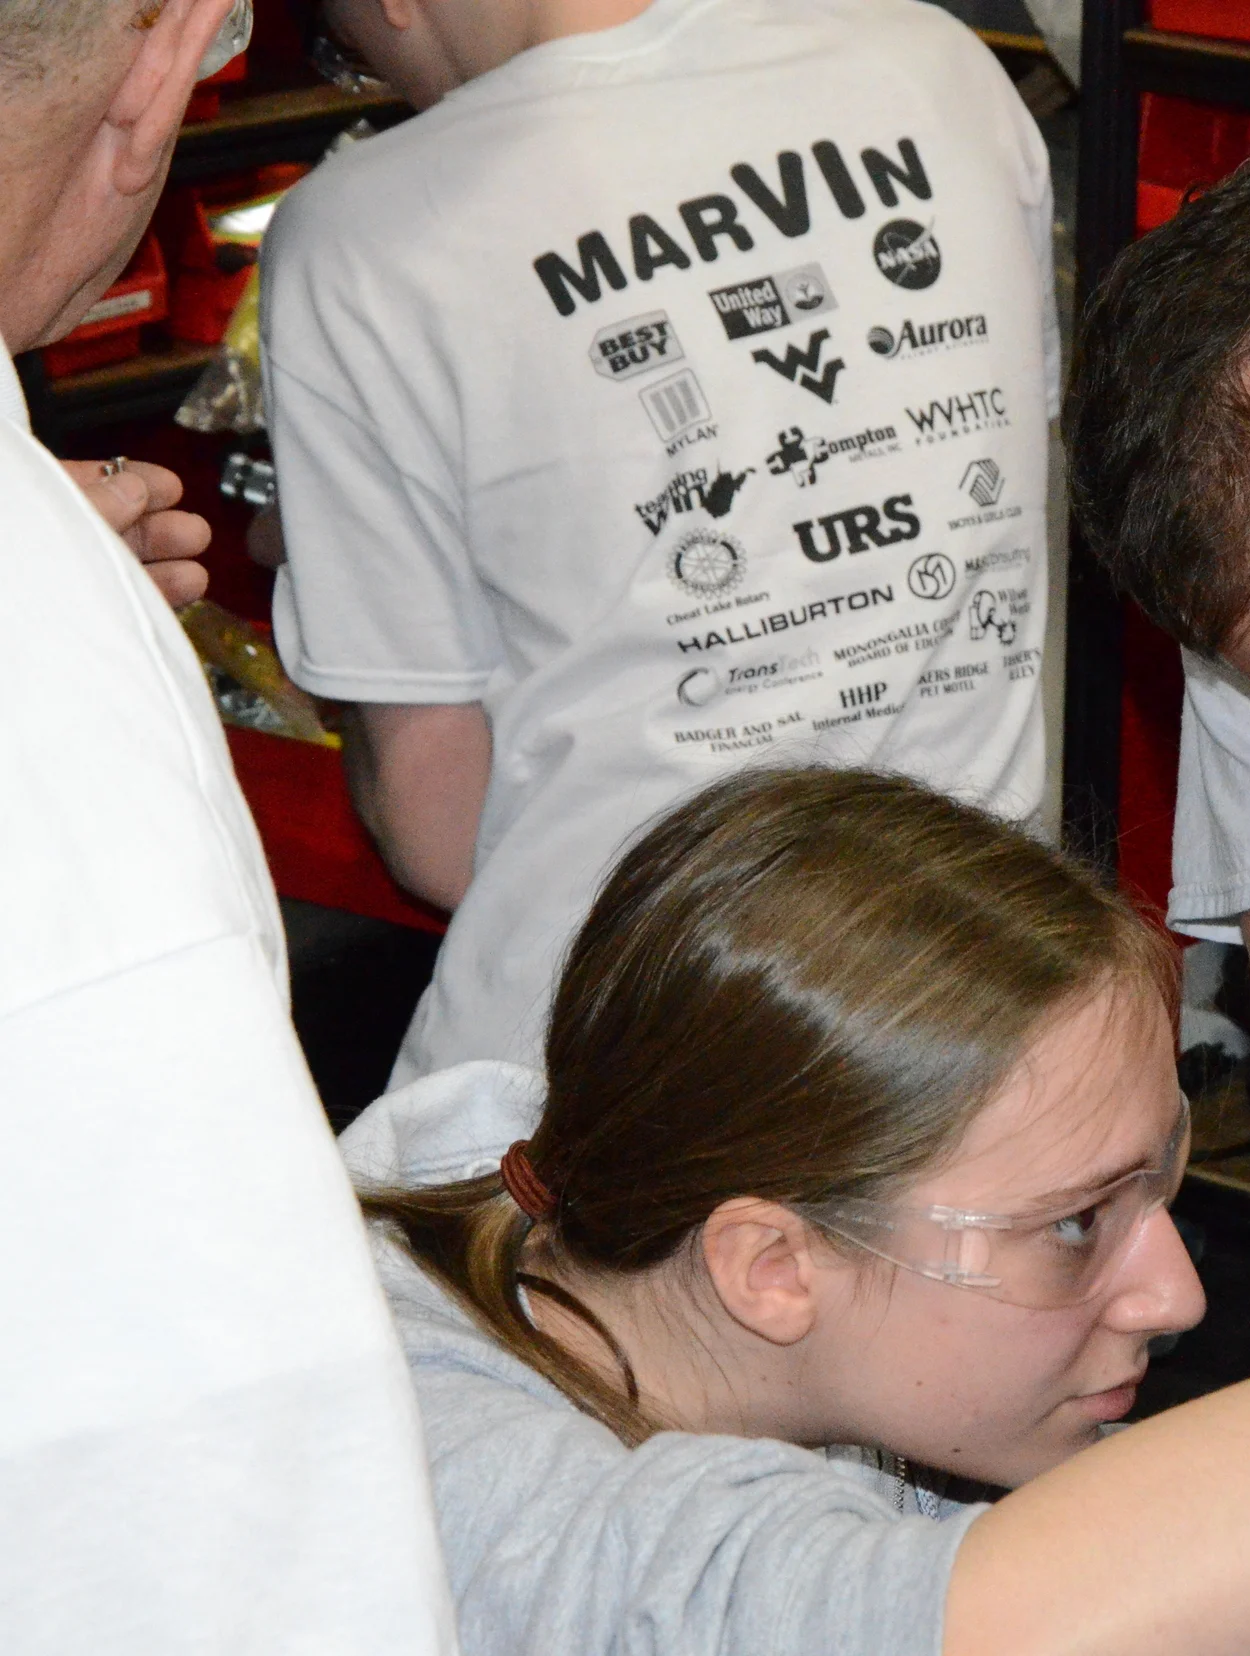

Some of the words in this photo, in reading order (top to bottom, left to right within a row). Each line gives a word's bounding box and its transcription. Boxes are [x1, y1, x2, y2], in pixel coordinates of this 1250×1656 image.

[533, 138, 933, 317] MARVIN
[878, 240, 938, 270] NASA
[711, 281, 776, 314] United
[743, 304, 783, 328] Way
[898, 314, 988, 350] Aurora
[598, 320, 669, 357] BEST
[609, 336, 669, 373] BUY
[905, 387, 1007, 433] WVHTC
[665, 425, 718, 457] MYLAN
[792, 493, 921, 564] URS
[666, 608, 701, 626] Cheat
[704, 600, 732, 615] Lake
[734, 591, 772, 607] Rotary
[677, 585, 895, 653] HALLIBURTON
[833, 621, 930, 662] MONONGALIA
[847, 645, 891, 668] BOARD
[894, 640, 911, 655] OF
[954, 660, 989, 679] RIDGE
[839, 681, 888, 709] HHP
[674, 726, 738, 744] BADGER
[742, 721, 774, 738] AND
[812, 710, 862, 732] Internal
